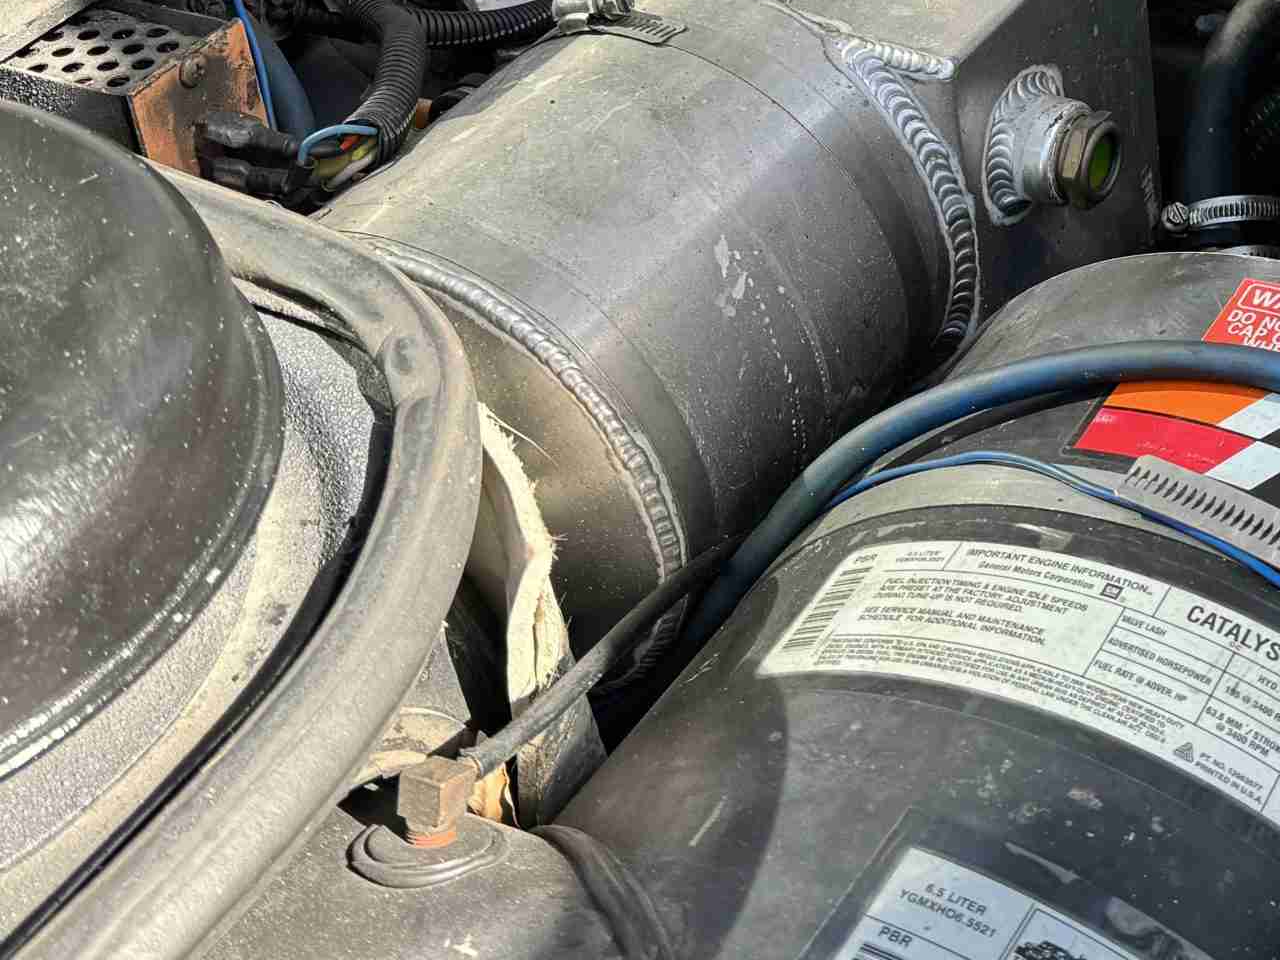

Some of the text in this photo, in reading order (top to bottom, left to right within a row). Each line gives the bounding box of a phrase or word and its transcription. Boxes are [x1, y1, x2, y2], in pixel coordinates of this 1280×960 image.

[1228, 307, 1256, 326] DO
[1226, 320, 1266, 339] CAP
[1027, 555, 1070, 571] ENGINE
[1012, 564, 1041, 577] Motors
[1043, 570, 1094, 590] Corporation
[1145, 623, 1166, 637] LASH
[924, 881, 987, 916] 6.5 LITER
[877, 926, 912, 948] PBR
